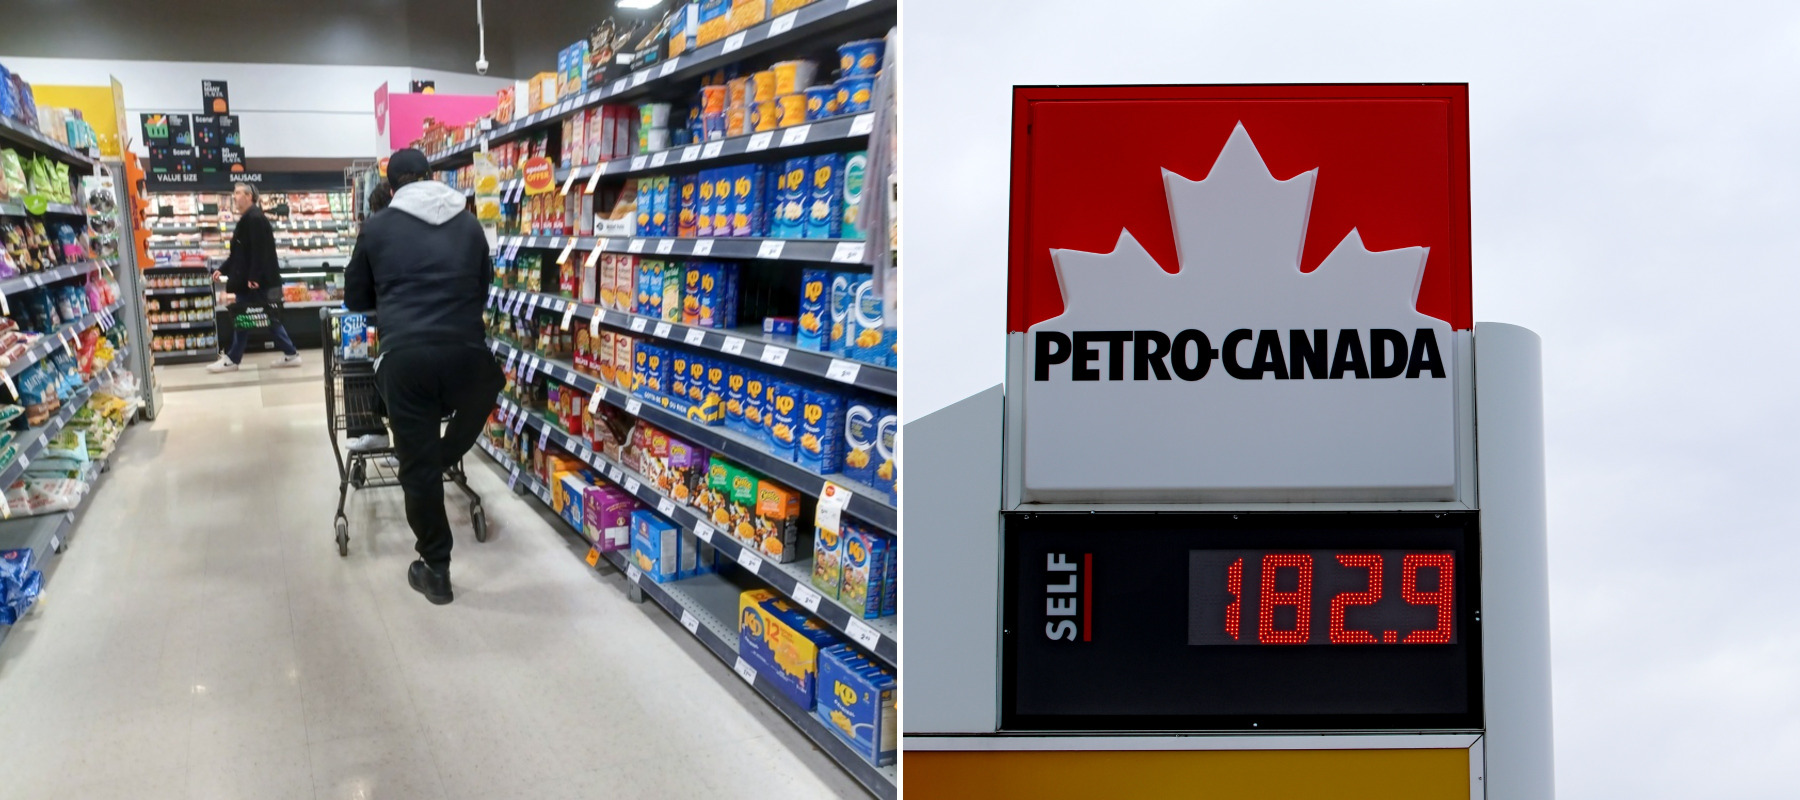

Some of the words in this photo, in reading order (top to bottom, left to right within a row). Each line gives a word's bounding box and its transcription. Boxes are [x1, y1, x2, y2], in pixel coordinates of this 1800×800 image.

[156, 173, 181, 182] VALUE
[183, 174, 198, 182] SIZE
[229, 173, 262, 182] SAUSAGE
[526, 163, 548, 174] special
[527, 171, 550, 182] OFFER
[814, 166, 831, 189] KD
[715, 178, 731, 200] KD
[735, 176, 751, 198] KD
[786, 168, 804, 191] KD
[805, 281, 823, 302] KD
[343, 314, 366, 333] Silk
[1034, 328, 1446, 381] PETRO-CANADA
[674, 359, 686, 374] KD
[690, 363, 703, 379] KD
[708, 368, 722, 385] KD
[729, 375, 743, 391] KD
[747, 381, 762, 398] KD
[775, 395, 795, 415] KD
[804, 403, 822, 425] KD
[848, 541, 866, 562] KD
[1046, 552, 1078, 642] SELF
[1225, 554, 1454, 644] 182.9
[744, 611, 762, 637] KD
[765, 618, 780, 642] 12
[834, 680, 857, 706] KD
